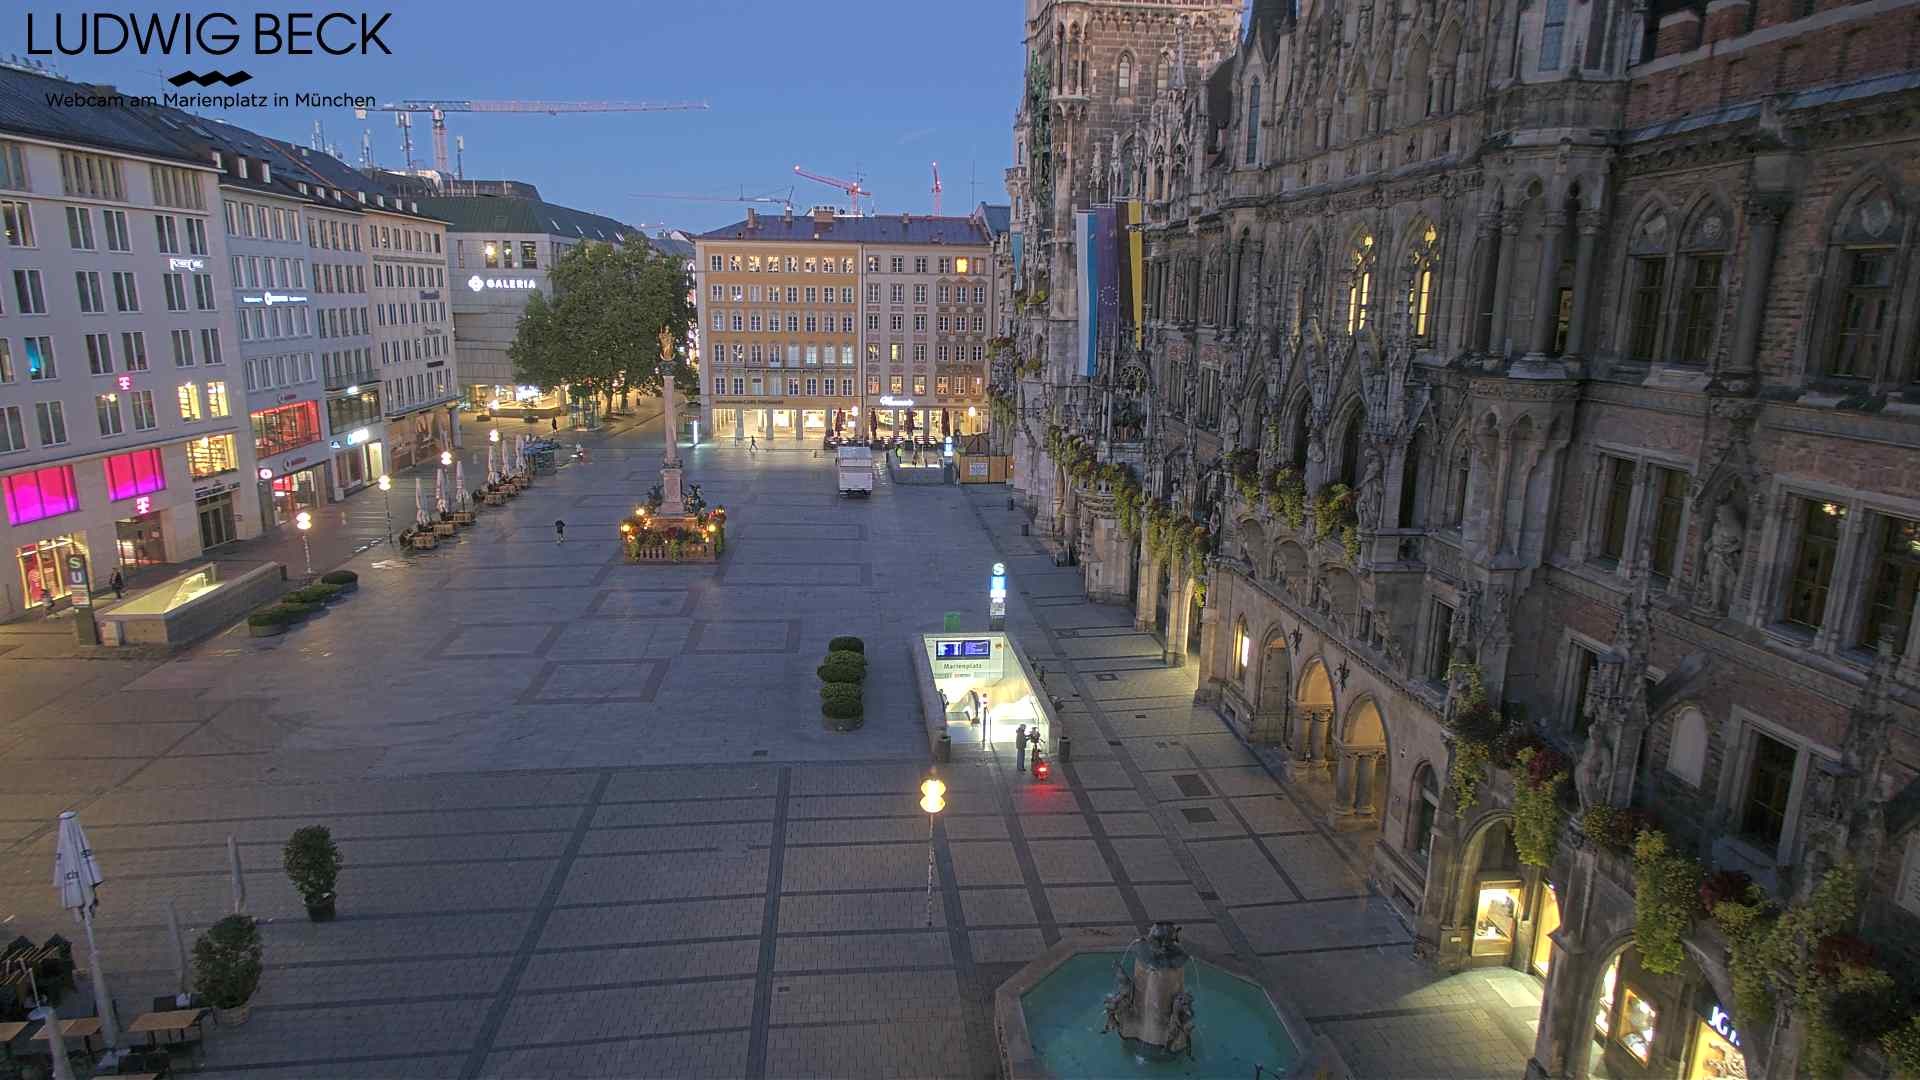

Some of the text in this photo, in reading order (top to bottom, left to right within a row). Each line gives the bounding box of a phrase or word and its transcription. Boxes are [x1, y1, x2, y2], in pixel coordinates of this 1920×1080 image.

[486, 279, 536, 289] GALERIA
[69, 557, 81, 568] S
[993, 562, 1005, 576] S
[71, 571, 82, 583] U
